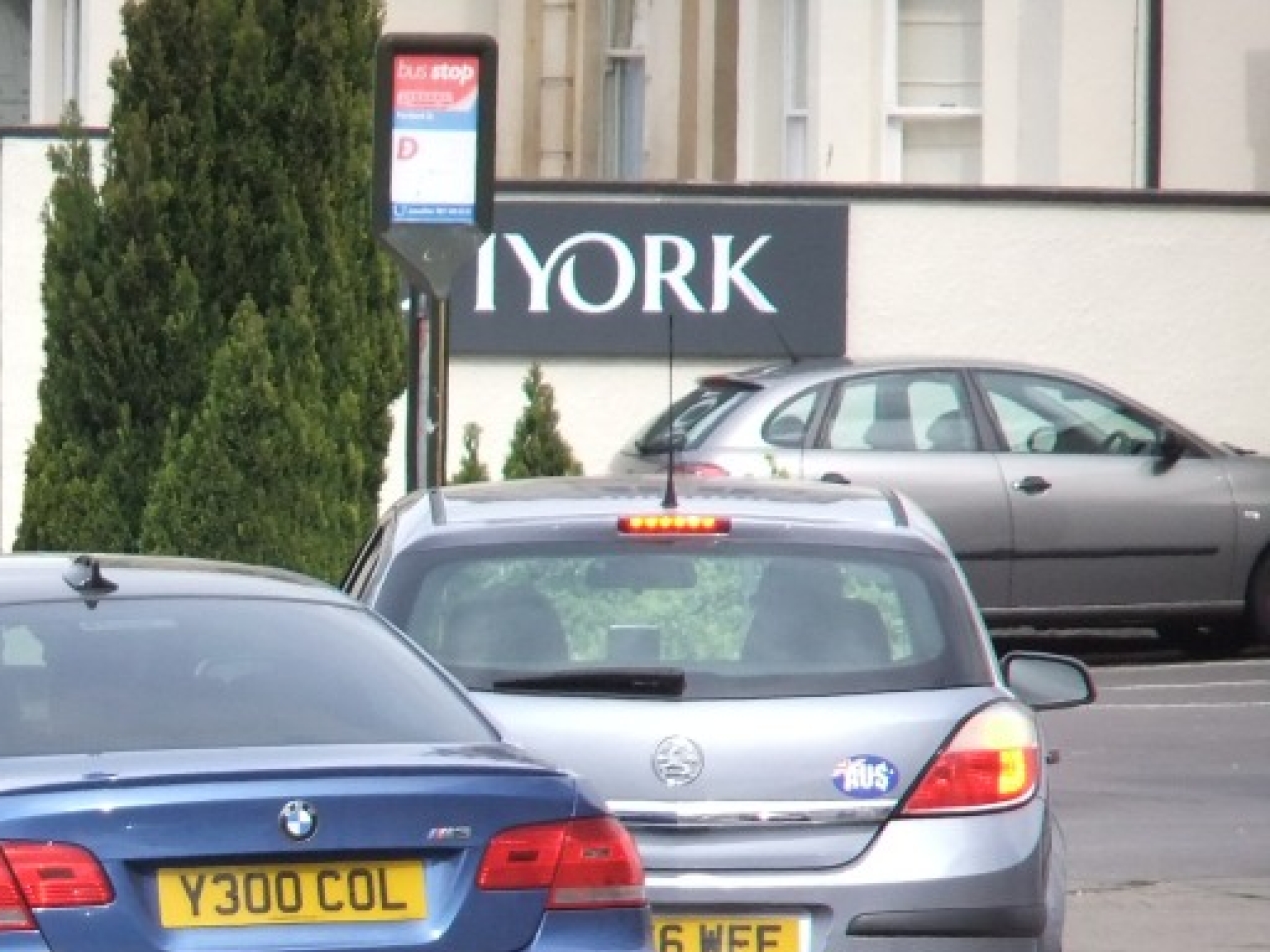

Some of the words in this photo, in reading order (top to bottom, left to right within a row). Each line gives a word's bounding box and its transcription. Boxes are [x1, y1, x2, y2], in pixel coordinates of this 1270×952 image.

[397, 60, 428, 79] bus
[431, 62, 475, 87] stop
[397, 136, 420, 160] D
[180, 869, 304, 916] Y300
[316, 867, 408, 911] COL
